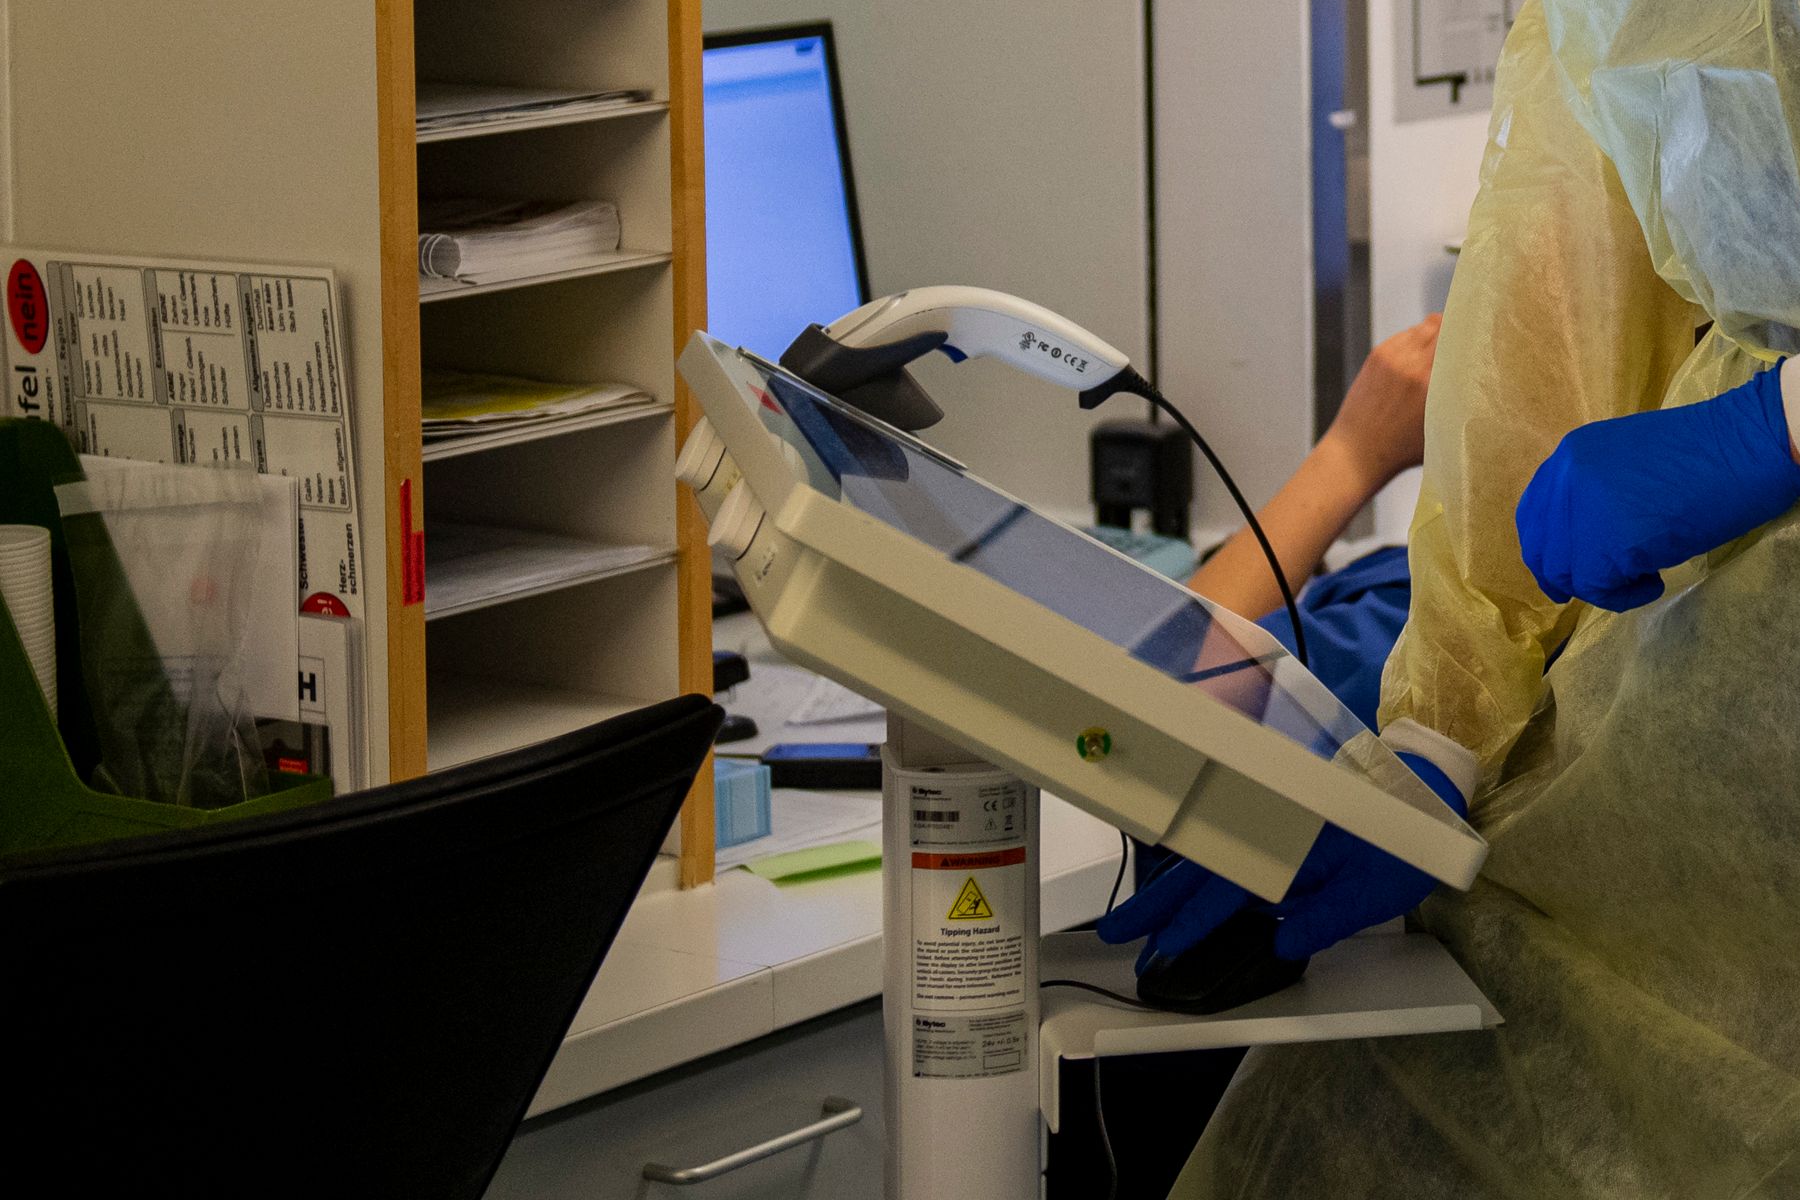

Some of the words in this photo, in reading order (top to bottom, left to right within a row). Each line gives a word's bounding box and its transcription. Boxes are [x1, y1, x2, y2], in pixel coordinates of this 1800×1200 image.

[15, 273, 38, 342] nein
[244, 292, 254, 336] Angaben
[58, 318, 66, 360] Region
[136, 358, 144, 398] Knochen
[249, 339, 260, 393] Allgemeine
[339, 559, 348, 594] Herz-
[345, 523, 357, 595] schmerzen
[941, 928, 971, 937] Tipping
[973, 925, 1000, 935] Hazard
